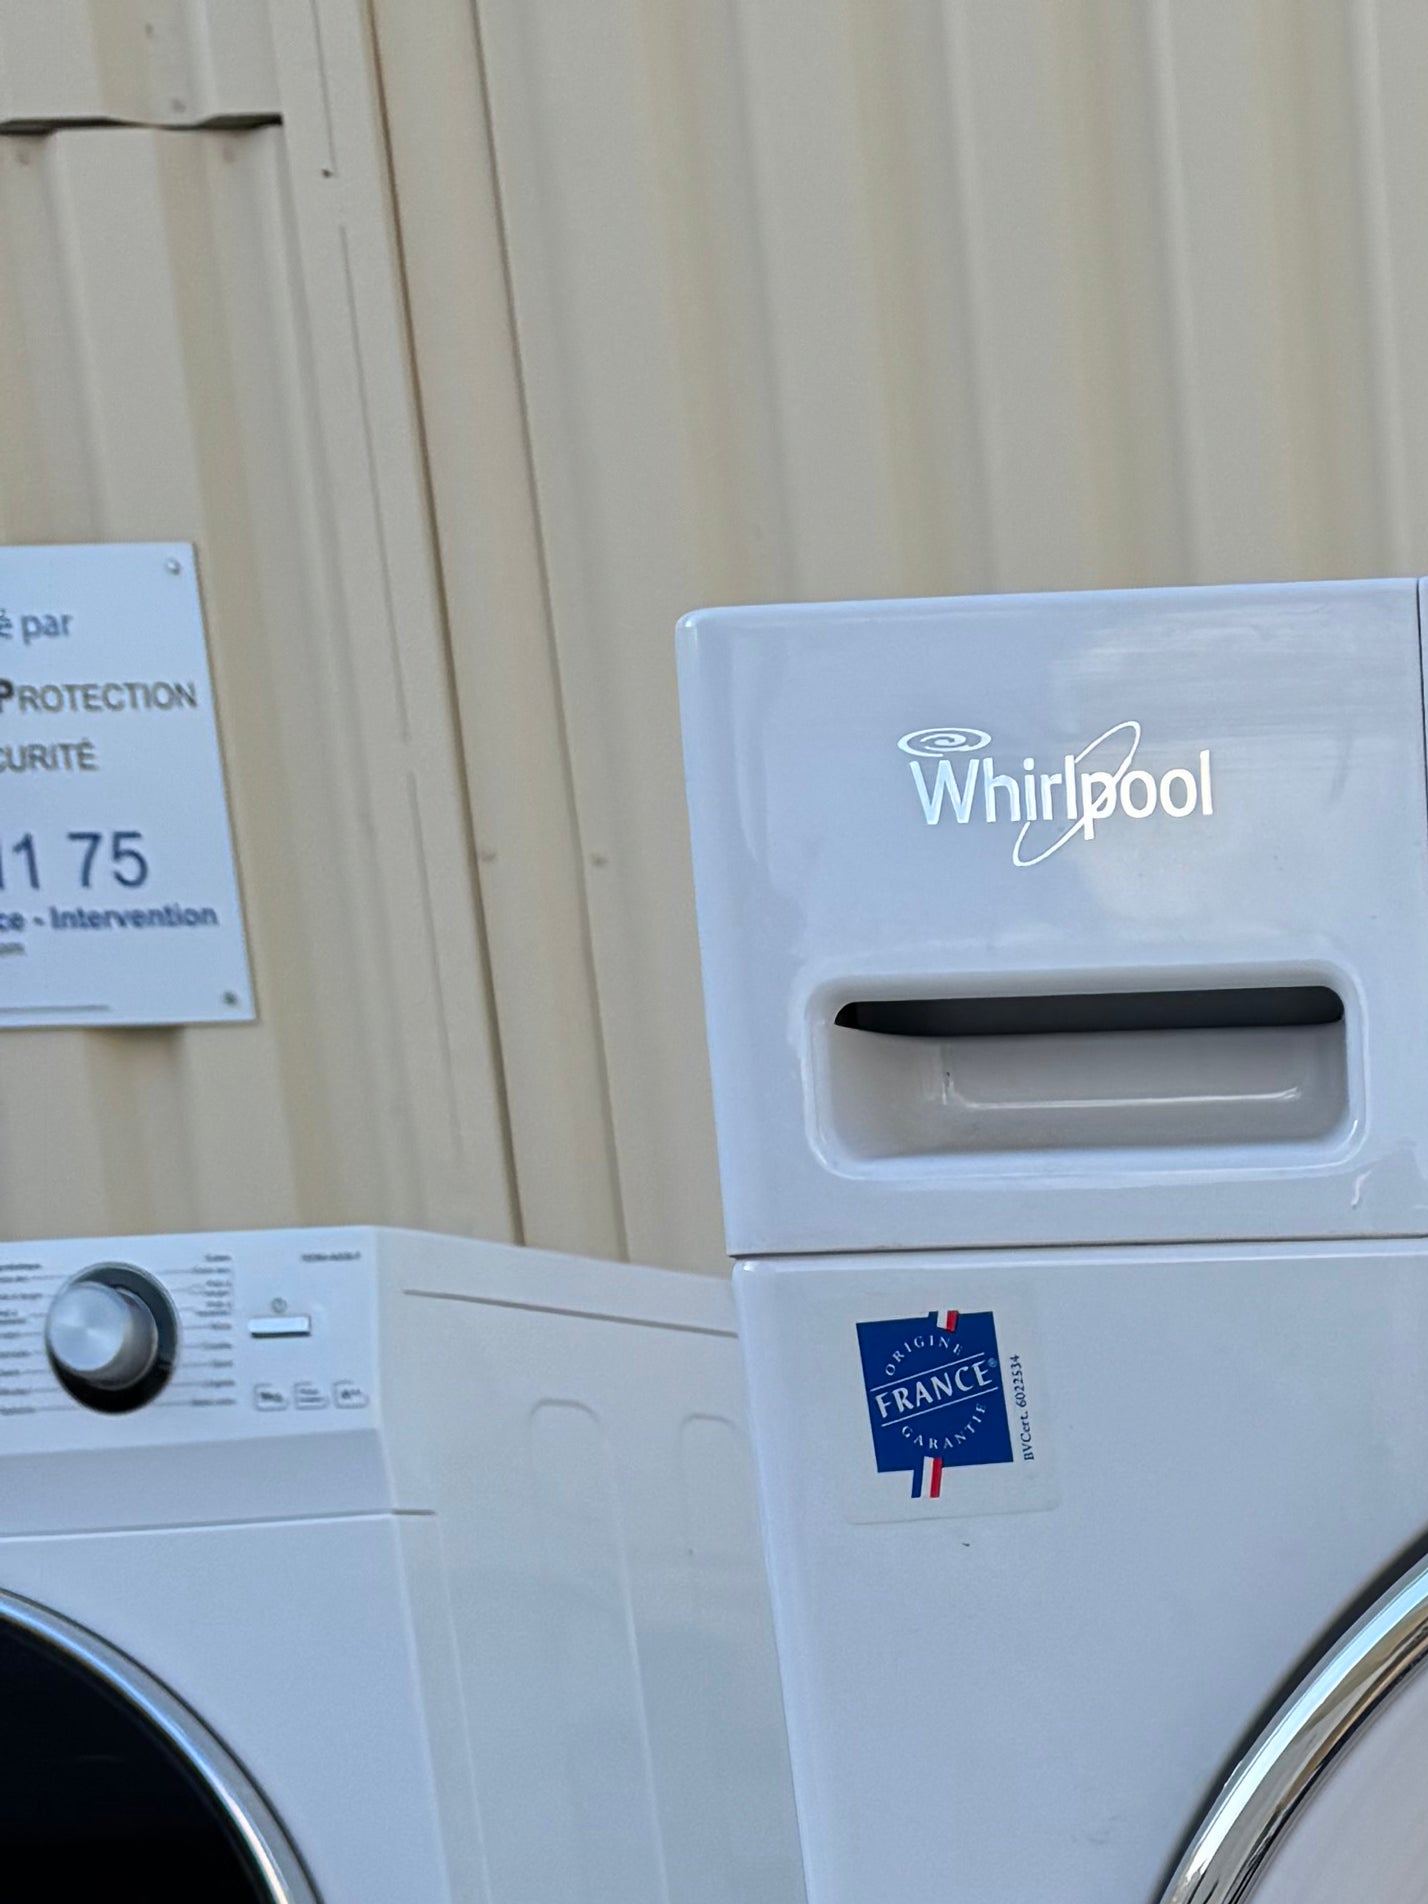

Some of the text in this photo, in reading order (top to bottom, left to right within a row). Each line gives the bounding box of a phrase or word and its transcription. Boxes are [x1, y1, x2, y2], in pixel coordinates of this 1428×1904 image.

[21, 614, 74, 645] par
[908, 748, 1214, 842] Whirlpool
[67, 830, 149, 889] 75
[51, 903, 219, 930] Intervention
[885, 1334, 964, 1377] ORIGINE
[901, 1402, 987, 1450] GARANTIE
